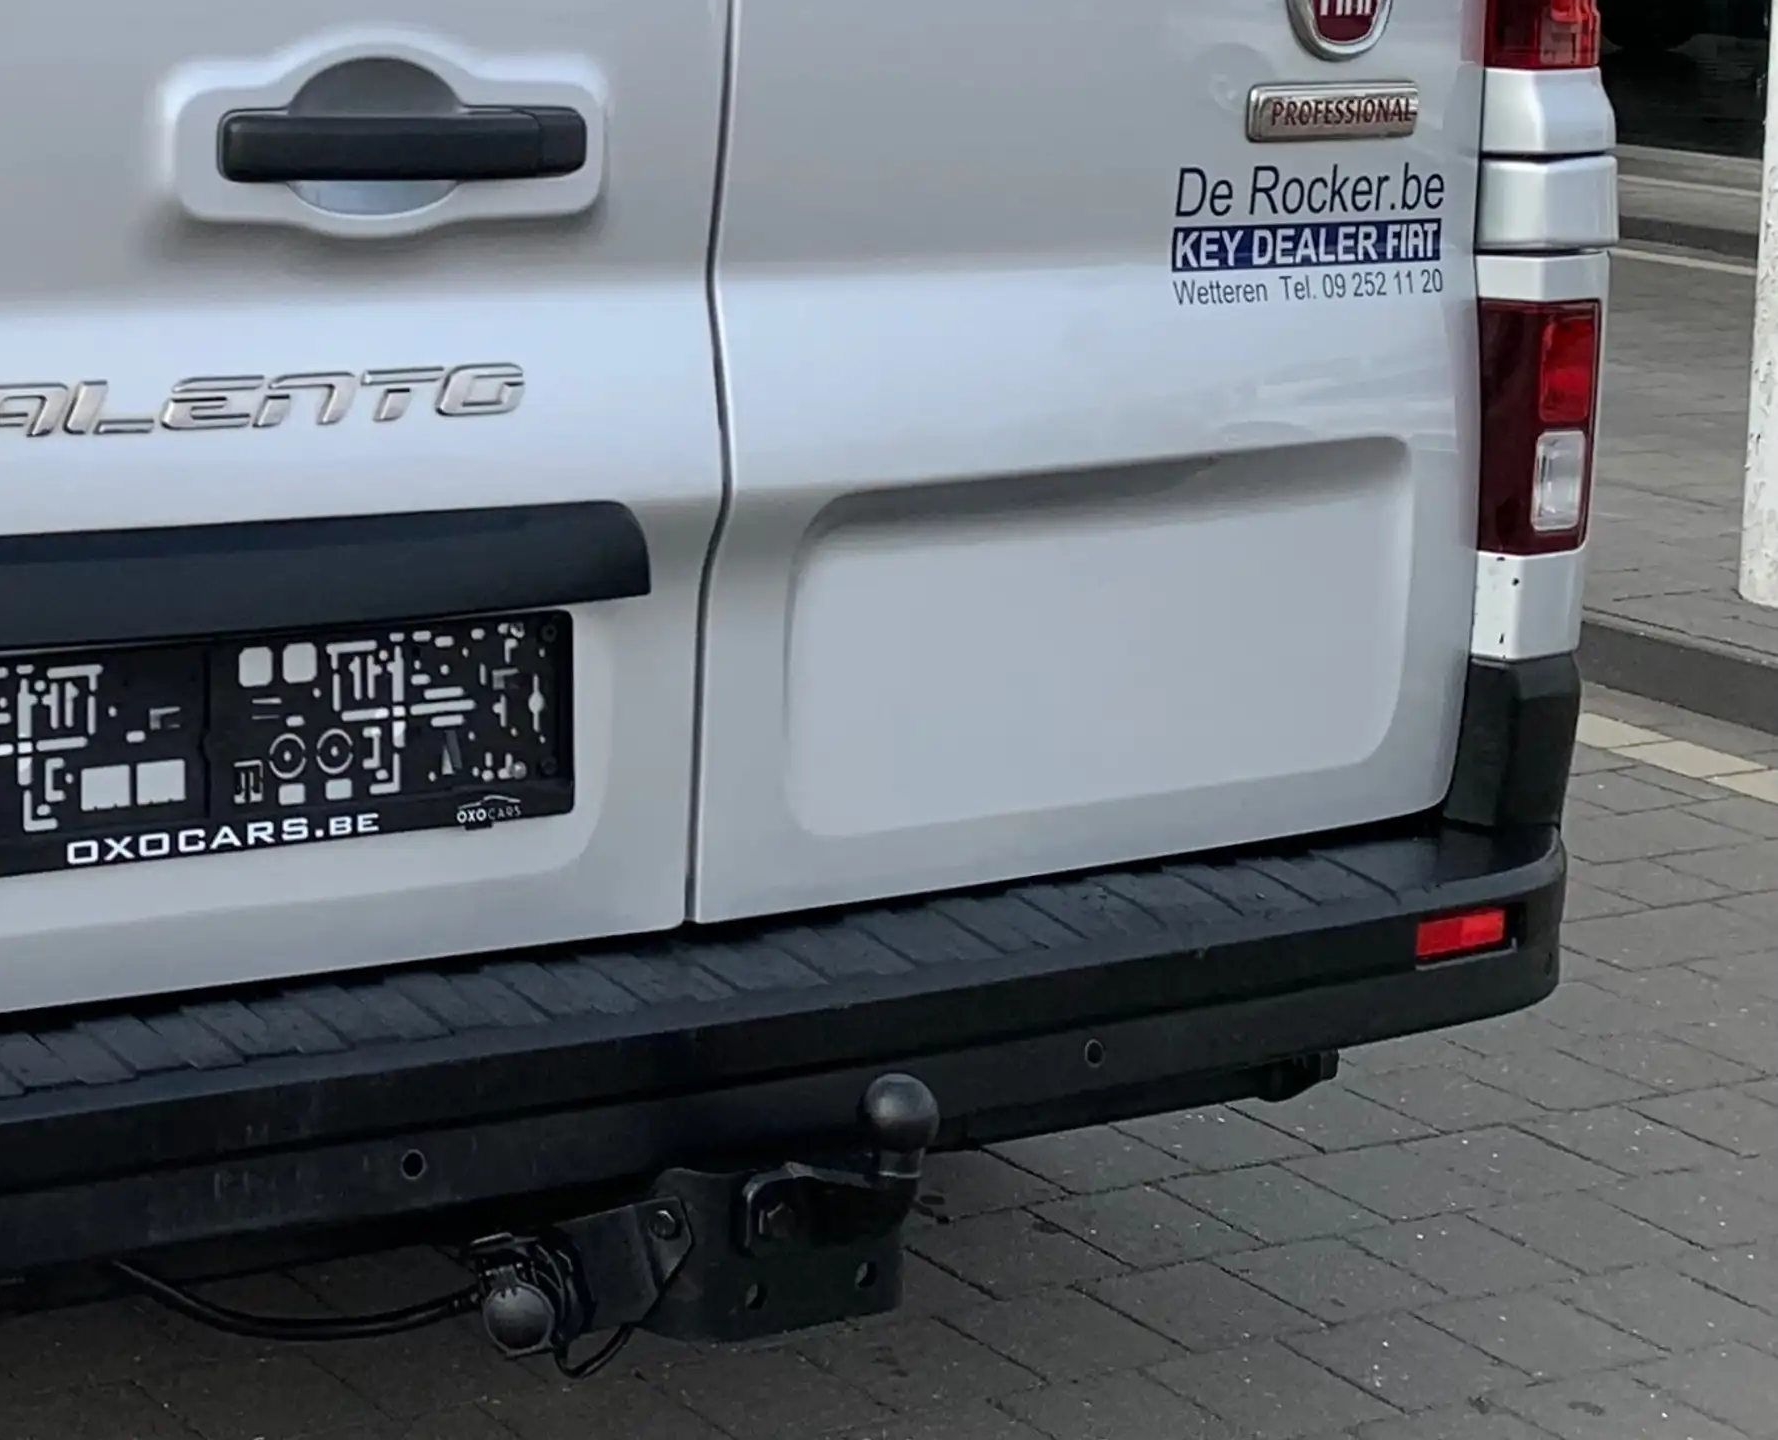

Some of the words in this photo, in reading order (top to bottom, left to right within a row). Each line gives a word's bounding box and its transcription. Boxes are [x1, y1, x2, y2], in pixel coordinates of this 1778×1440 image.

[1271, 96, 1413, 127] PROFESSIONAL
[1175, 166, 1233, 217] De
[1249, 161, 1445, 215] Rocker.be
[1174, 229, 1244, 268] KEY
[1251, 225, 1378, 265] DEALER
[1385, 222, 1439, 259] FIAT
[1173, 279, 1268, 305] Wetteren
[1279, 274, 1317, 300] Tel.
[1322, 273, 1347, 299] 09
[1352, 271, 1387, 298] 252
[1393, 270, 1415, 295] 11
[1421, 268, 1444, 293] 20
[456, 804, 522, 824] OXOCARS
[67, 812, 380, 865] OXOCARS.BE
